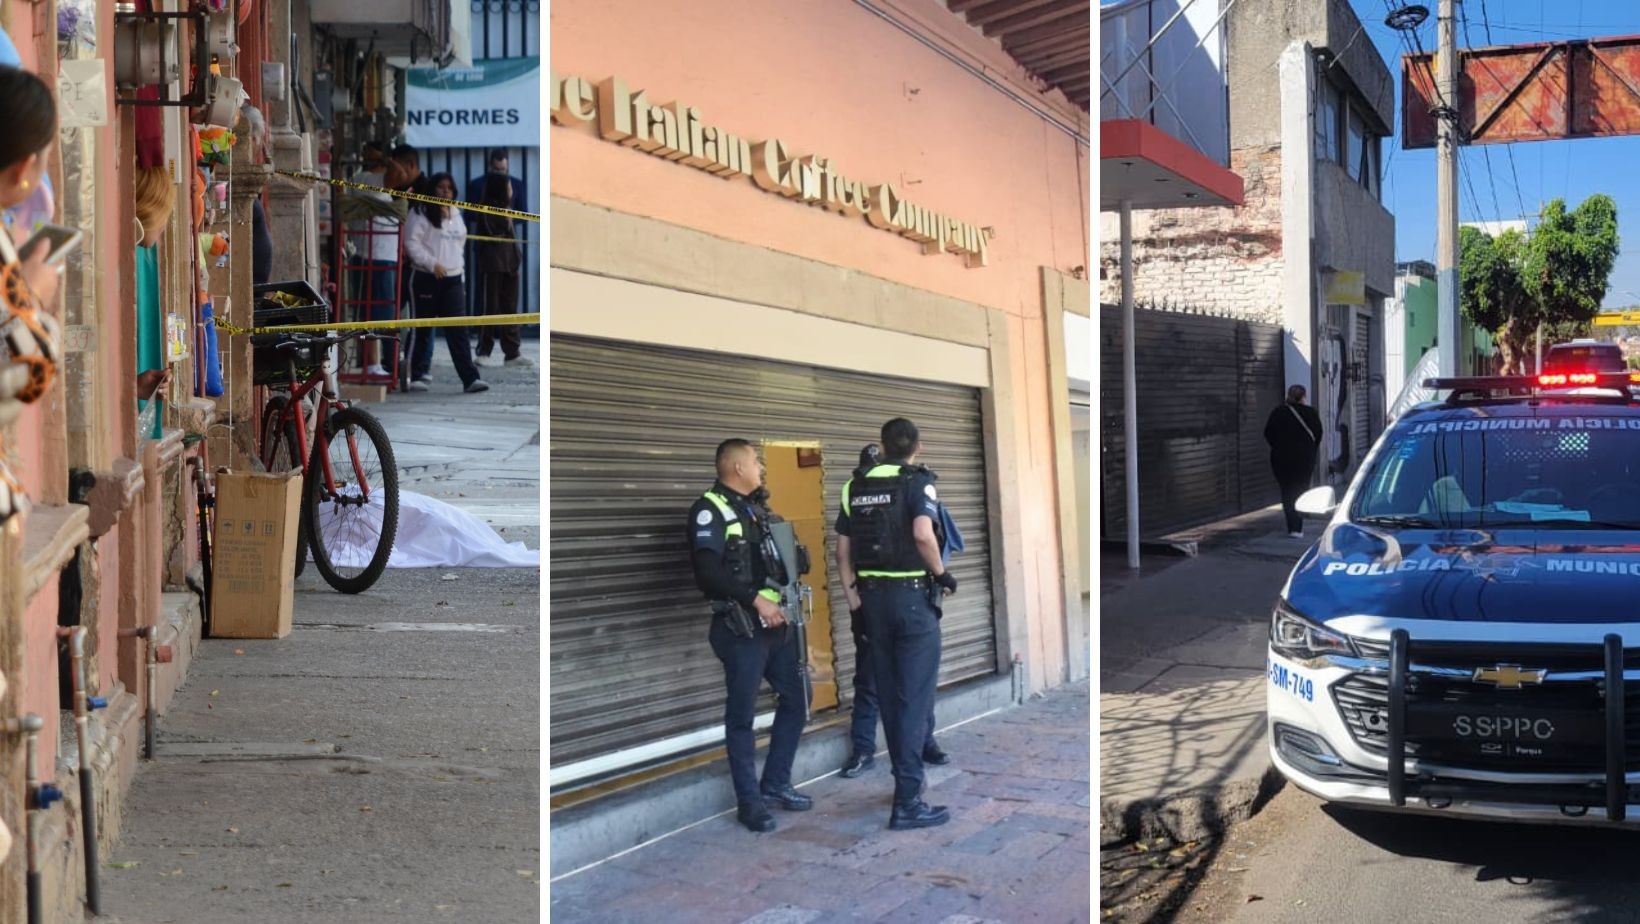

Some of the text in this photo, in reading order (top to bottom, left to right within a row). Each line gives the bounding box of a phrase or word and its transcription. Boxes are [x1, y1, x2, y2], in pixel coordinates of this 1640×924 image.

[602, 74, 752, 178] Italian
[755, 138, 870, 215] Coffee
[870, 182, 992, 267] Company
[1456, 715, 1552, 739] SSPPC
